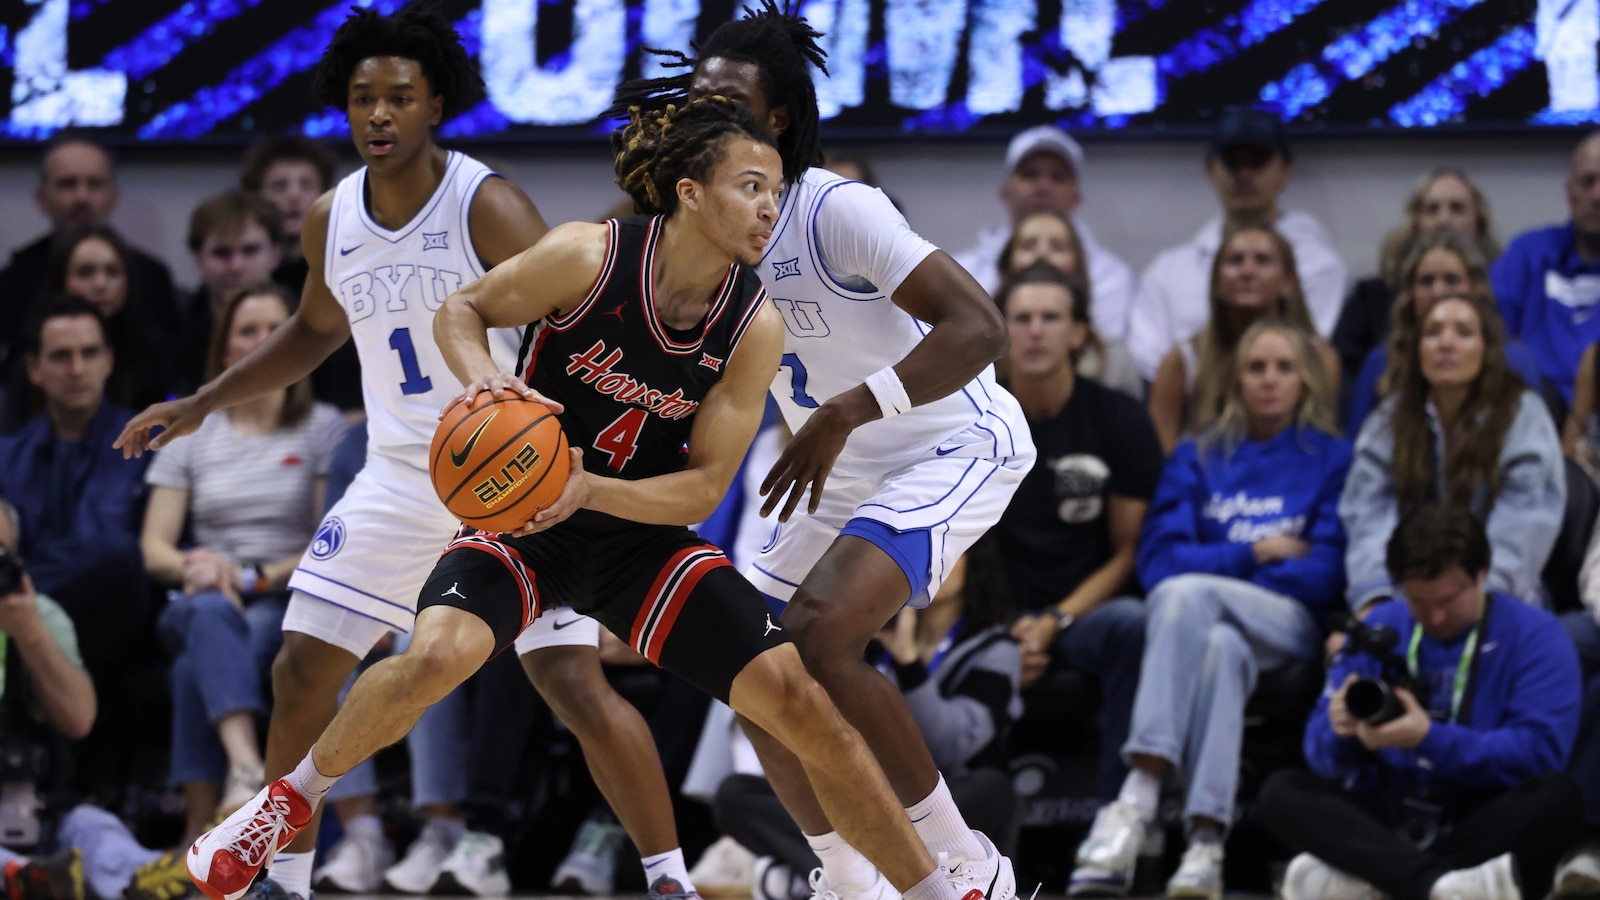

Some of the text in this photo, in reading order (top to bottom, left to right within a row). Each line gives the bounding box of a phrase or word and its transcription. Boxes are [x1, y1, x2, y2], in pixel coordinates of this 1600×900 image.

[340, 264, 462, 324] BYU
[389, 327, 433, 395] 1
[592, 407, 649, 473] 4
[472, 442, 541, 505] ELITE
